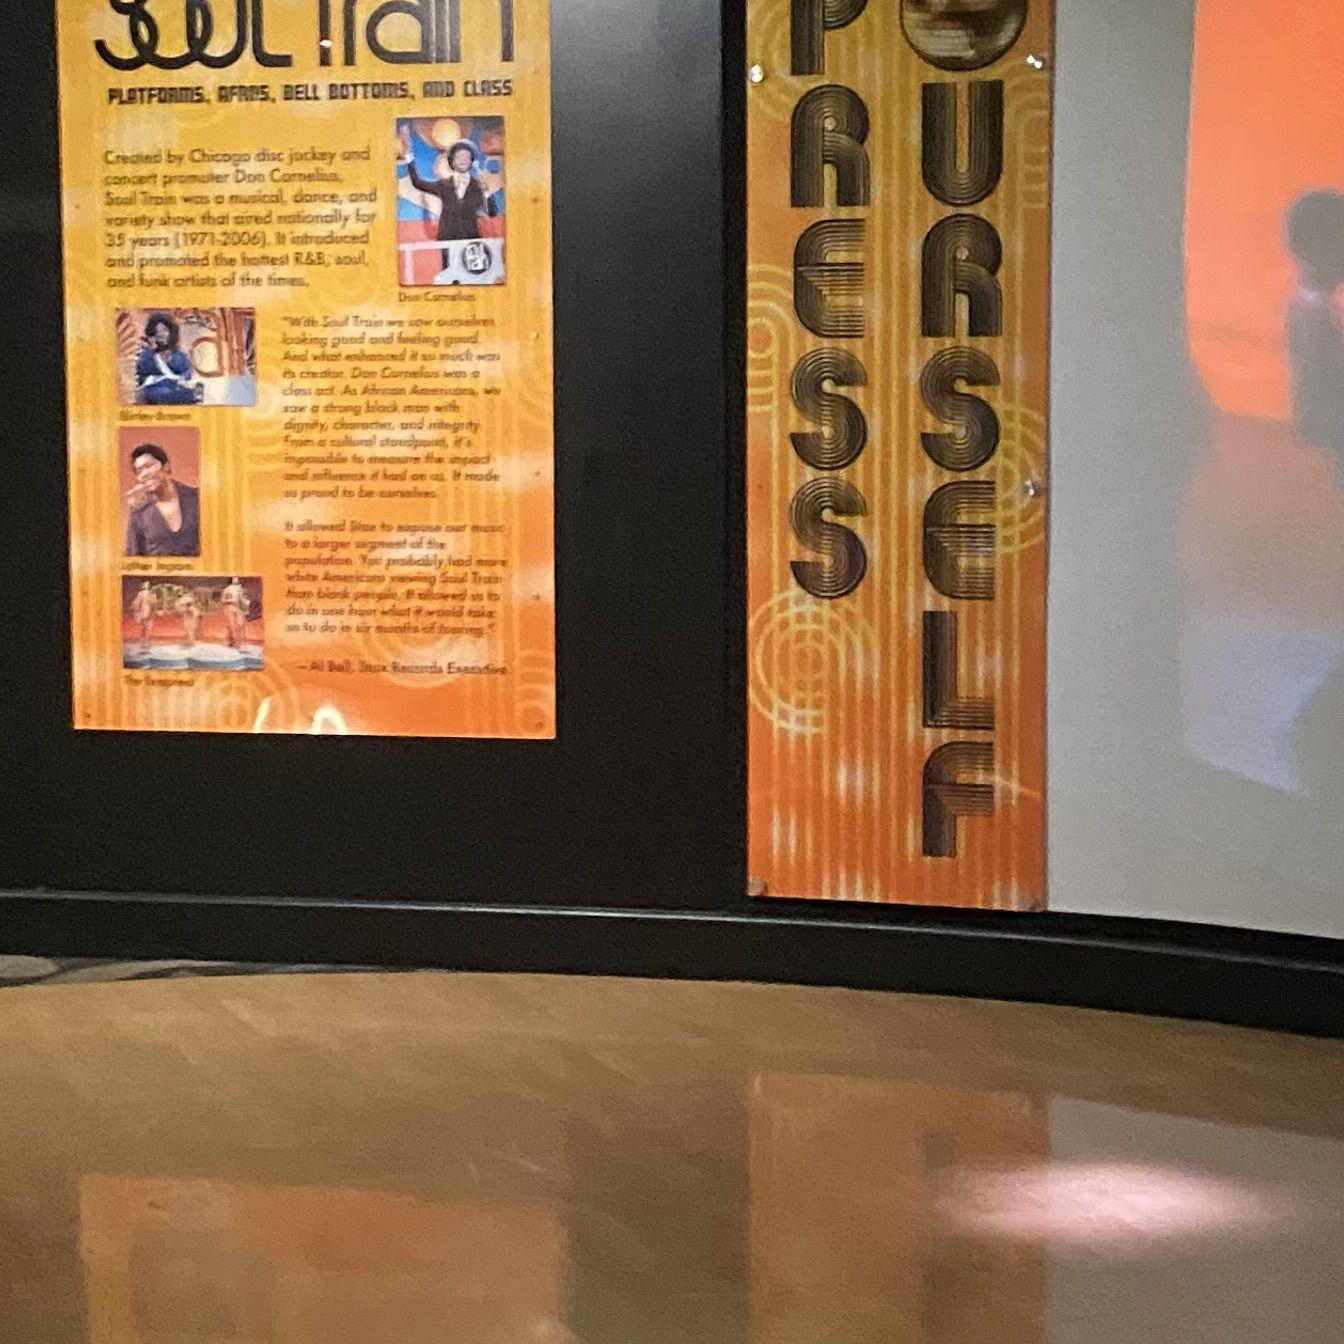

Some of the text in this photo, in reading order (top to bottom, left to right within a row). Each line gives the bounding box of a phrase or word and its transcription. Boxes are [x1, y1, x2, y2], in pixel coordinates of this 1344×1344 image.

[283, 83, 320, 101] BELL
[463, 78, 514, 97] CLASS
[104, 148, 162, 164] Created
[167, 149, 184, 166] by
[188, 146, 251, 166] Chicago
[255, 146, 284, 163] disc
[340, 144, 370, 161] and
[104, 172, 157, 186] concert
[163, 170, 230, 187] promoter
[234, 168, 265, 184] Don
[105, 191, 137, 206] Soul
[140, 190, 177, 206] Train
[182, 194, 210, 205] was
[215, 194, 225, 205] a
[348, 186, 376, 203] and
[106, 208, 375, 229] variety show that aired nationally for
[104, 232, 125, 247] 35
[129, 234, 170, 250] years
[275, 231, 286, 246] It
[290, 229, 369, 246] introduced
[106, 252, 134, 268] and
[137, 250, 210, 270] promoted
[214, 251, 236, 267] the
[106, 273, 135, 288] and
[138, 272, 171, 288] funk
[174, 272, 218, 287] artists
[221, 271, 235, 287] of
[240, 270, 263, 287] the
[352, 314, 383, 328] Train
[368, 330, 394, 345] and
